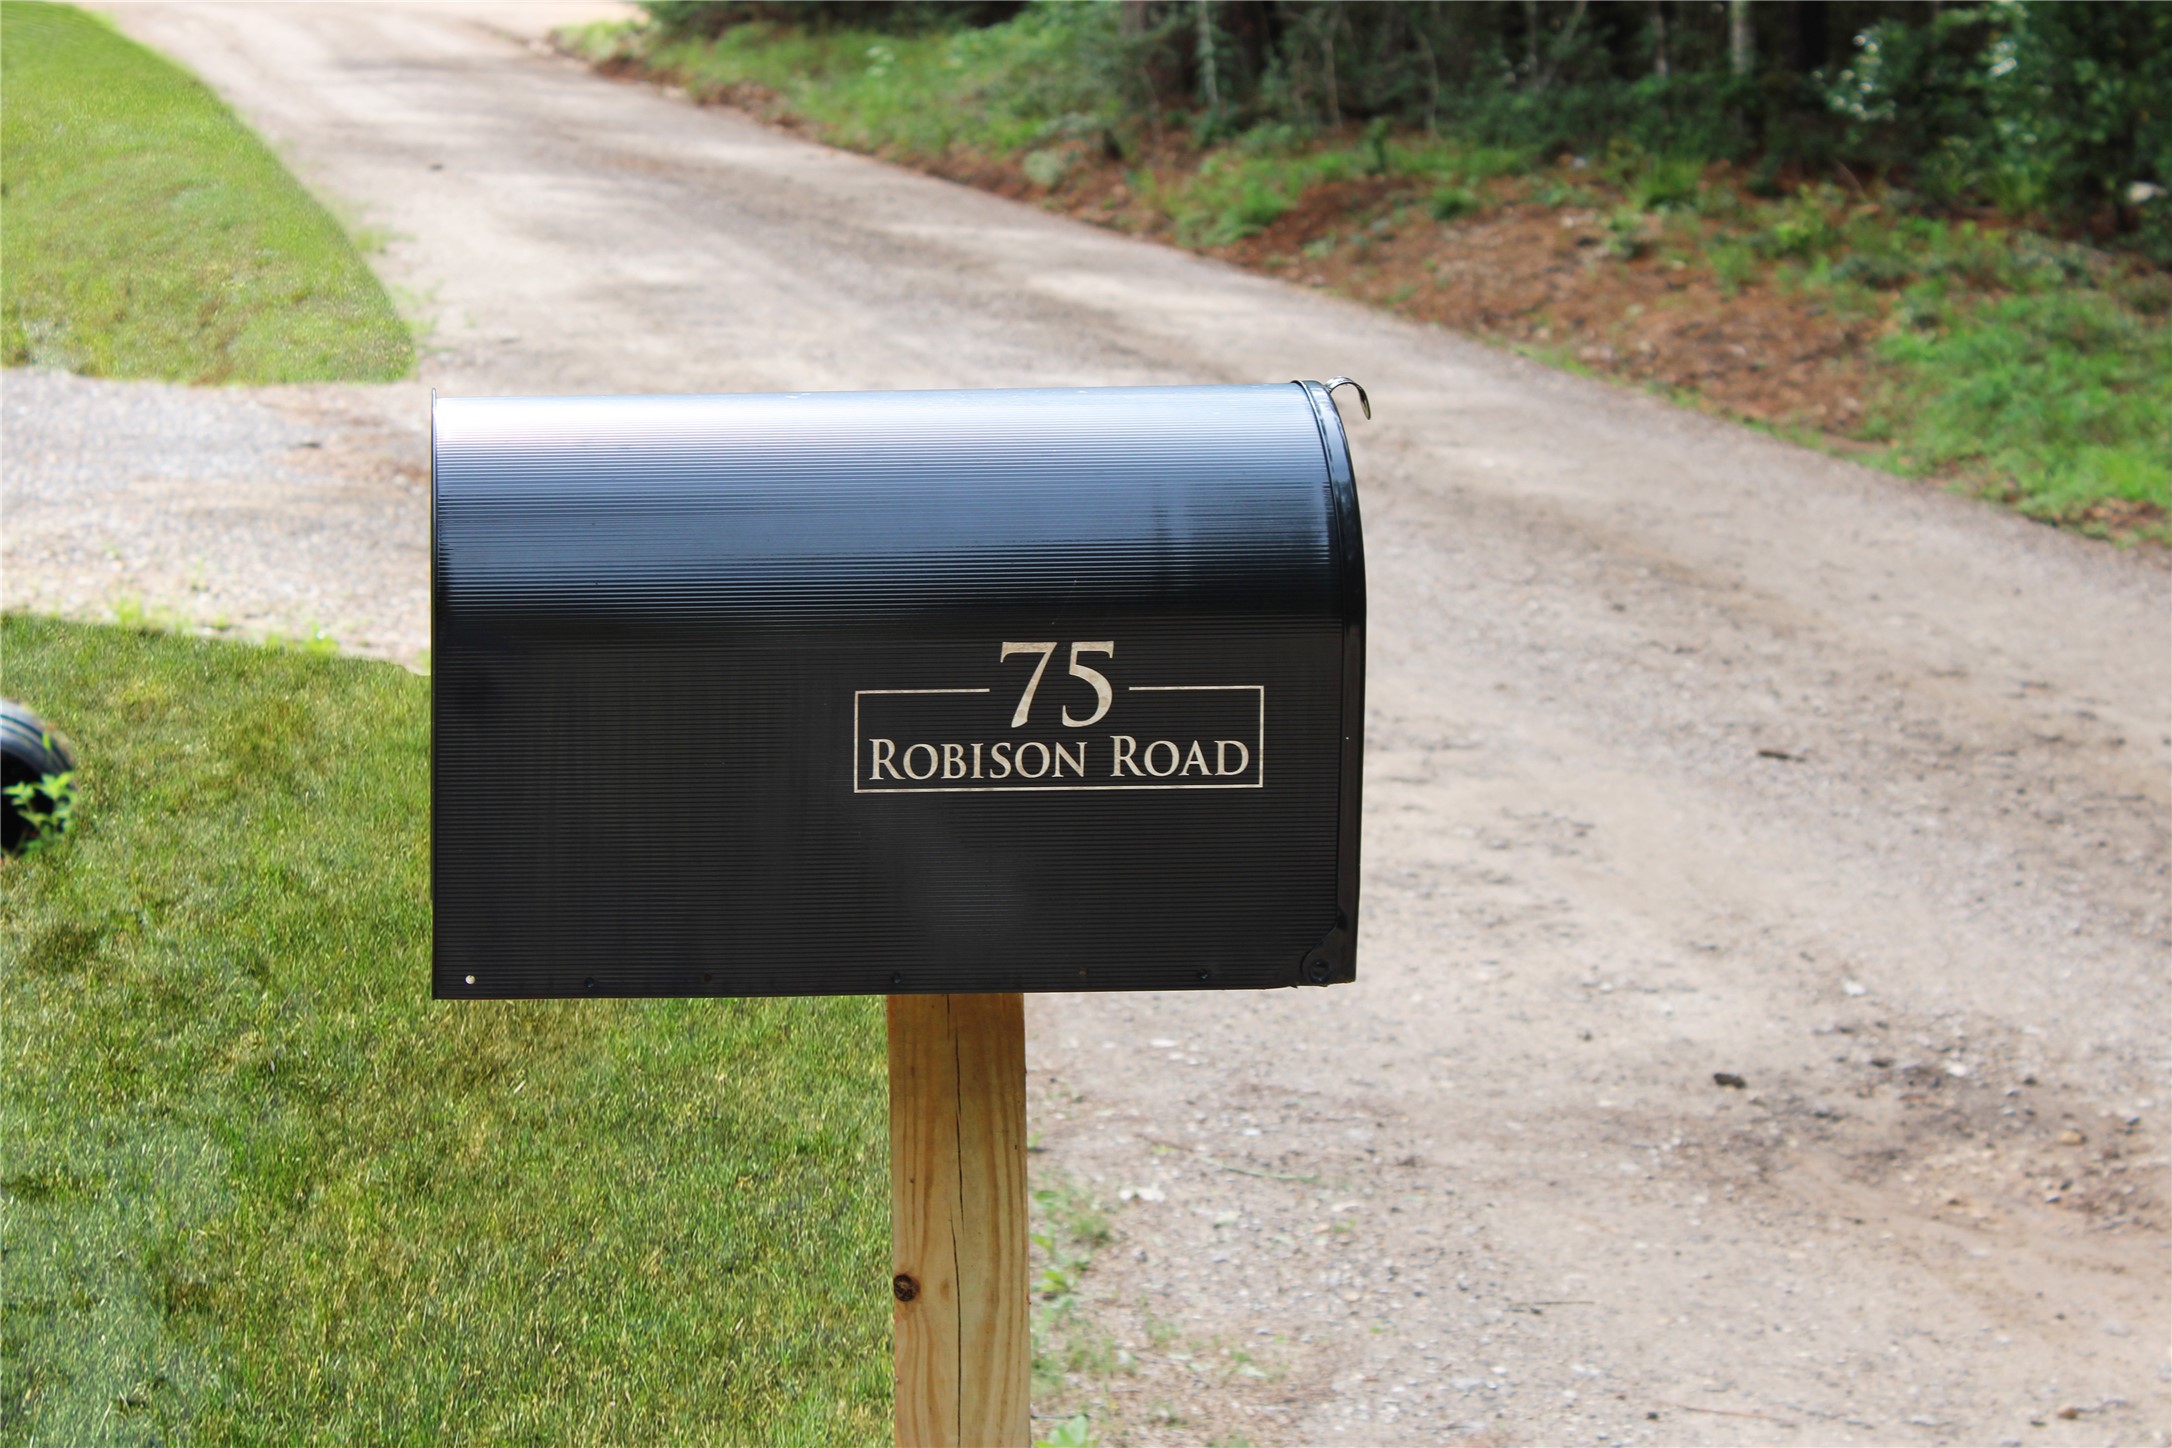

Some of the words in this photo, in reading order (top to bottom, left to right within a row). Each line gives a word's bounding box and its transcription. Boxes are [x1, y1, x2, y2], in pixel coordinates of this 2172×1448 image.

[1000, 640, 1115, 728] 75
[868, 738, 1088, 781] ROBISON
[1109, 735, 1249, 777] ROAD
